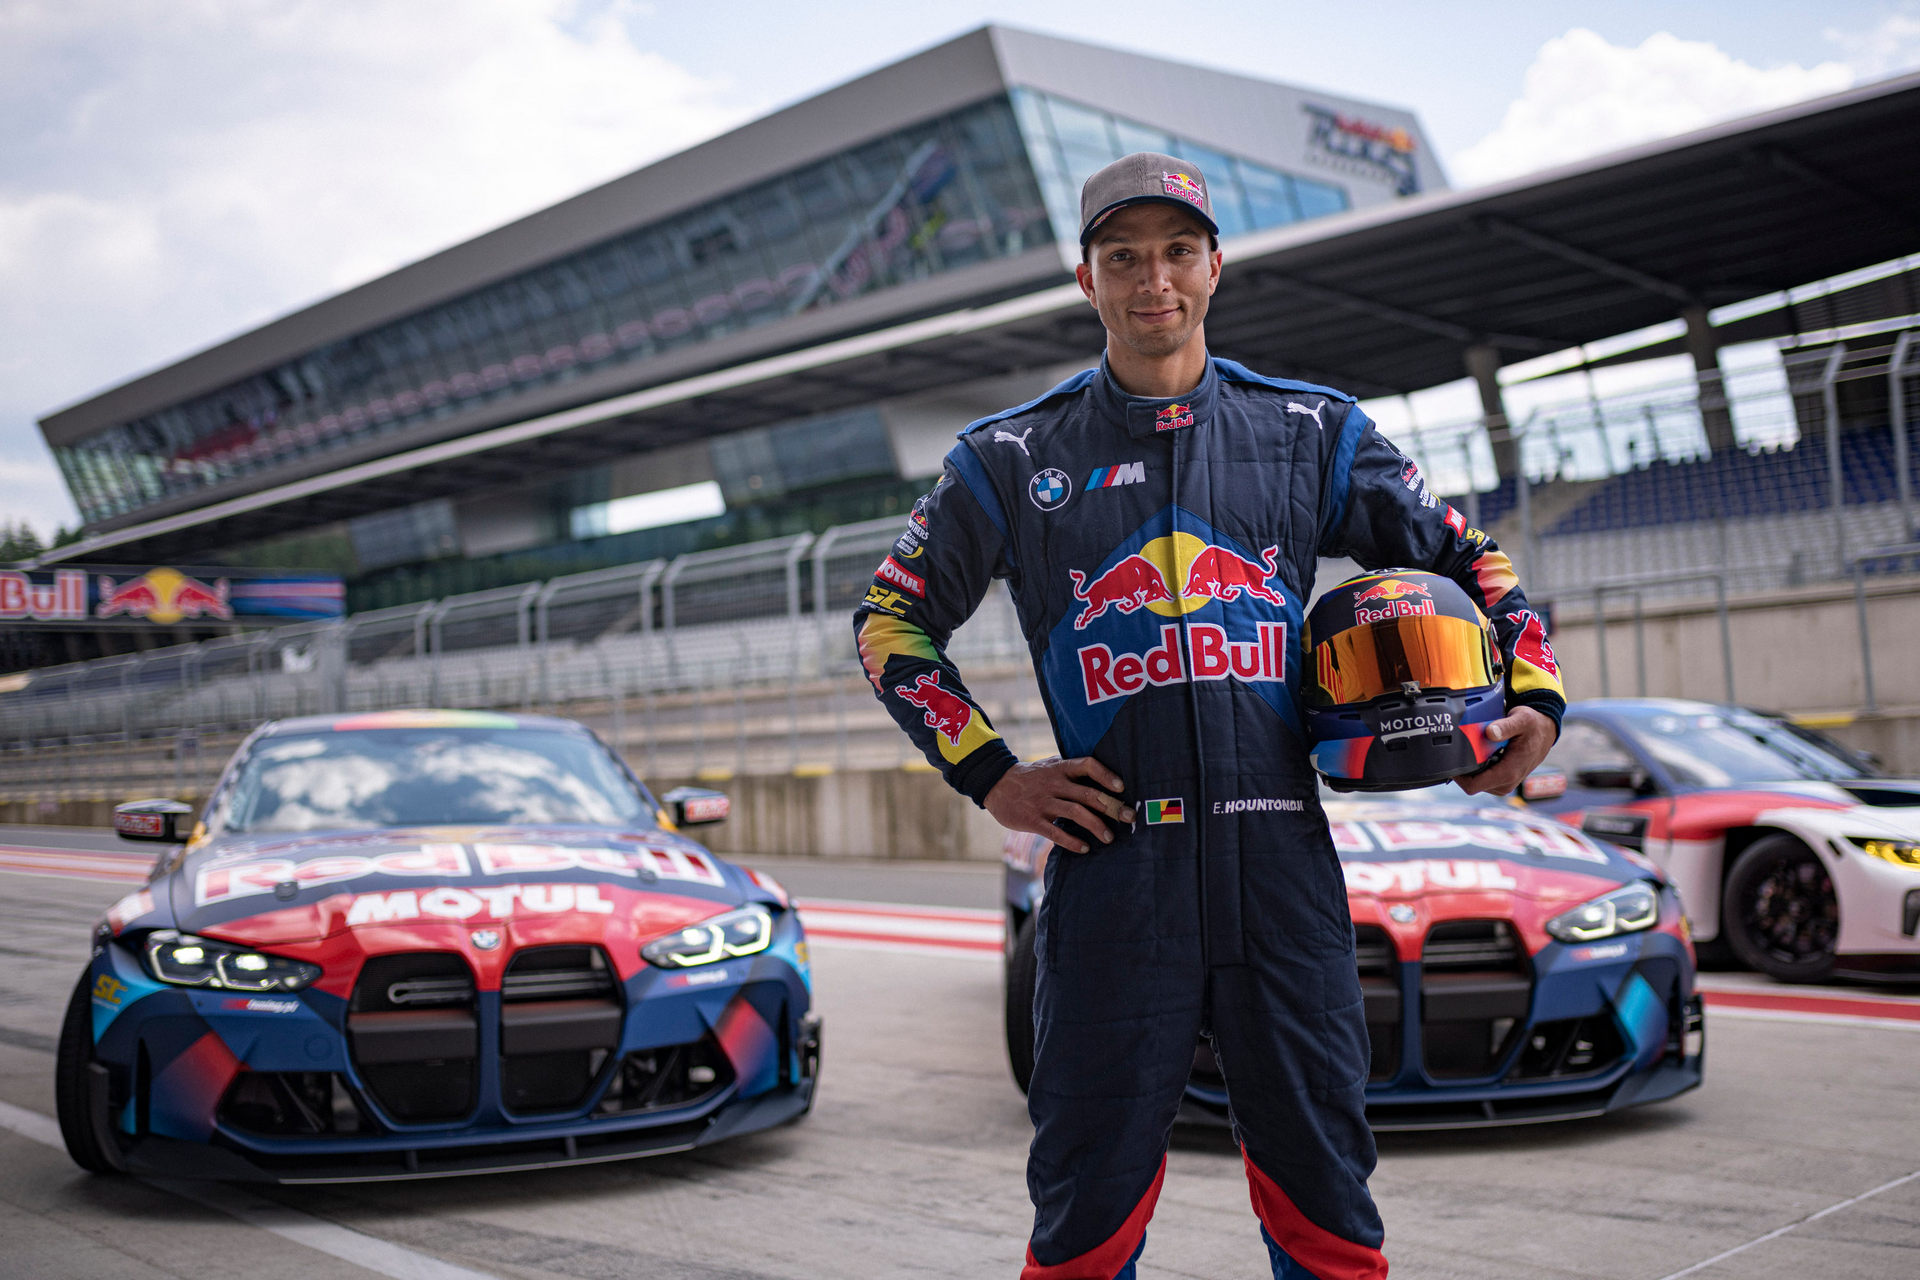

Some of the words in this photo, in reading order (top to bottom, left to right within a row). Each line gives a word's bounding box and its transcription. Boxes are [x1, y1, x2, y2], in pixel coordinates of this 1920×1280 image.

[1165, 183, 1186, 199] Red
[1187, 191, 1203, 209] Bull
[1156, 419, 1176, 432] Red
[1176, 414, 1194, 429] Bull
[0, 569, 88, 621] Bull
[1355, 602, 1396, 625] Red
[1396, 599, 1436, 616] Bull
[1078, 624, 1186, 704] Red
[1188, 622, 1286, 683] Bull
[196, 843, 471, 907] Red
[475, 842, 726, 887] Bull
[1346, 859, 1517, 893] OTUL
[346, 885, 614, 926] MOTUL
